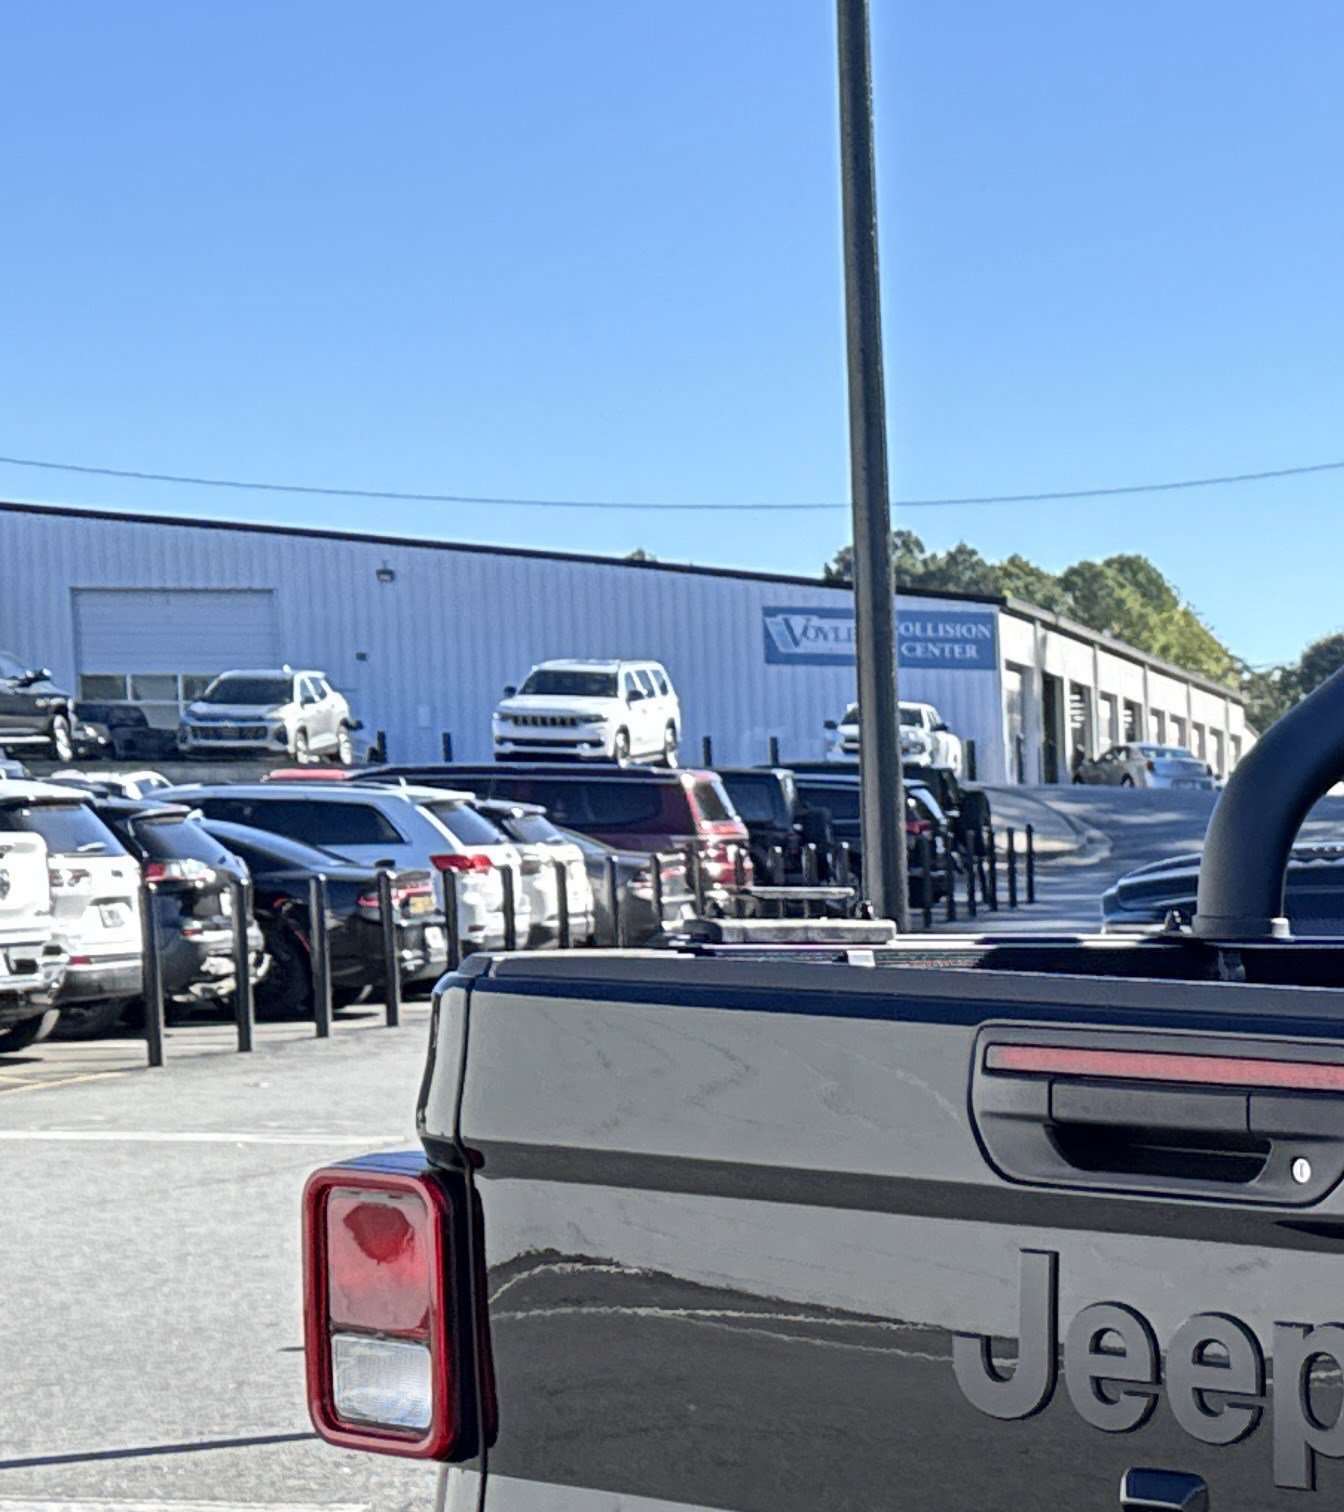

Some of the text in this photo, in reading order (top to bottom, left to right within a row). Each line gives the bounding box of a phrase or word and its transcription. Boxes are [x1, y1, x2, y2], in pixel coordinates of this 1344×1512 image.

[782, 615, 856, 648] VOYL
[898, 620, 992, 640] OLLISION
[901, 641, 978, 660] CENTER
